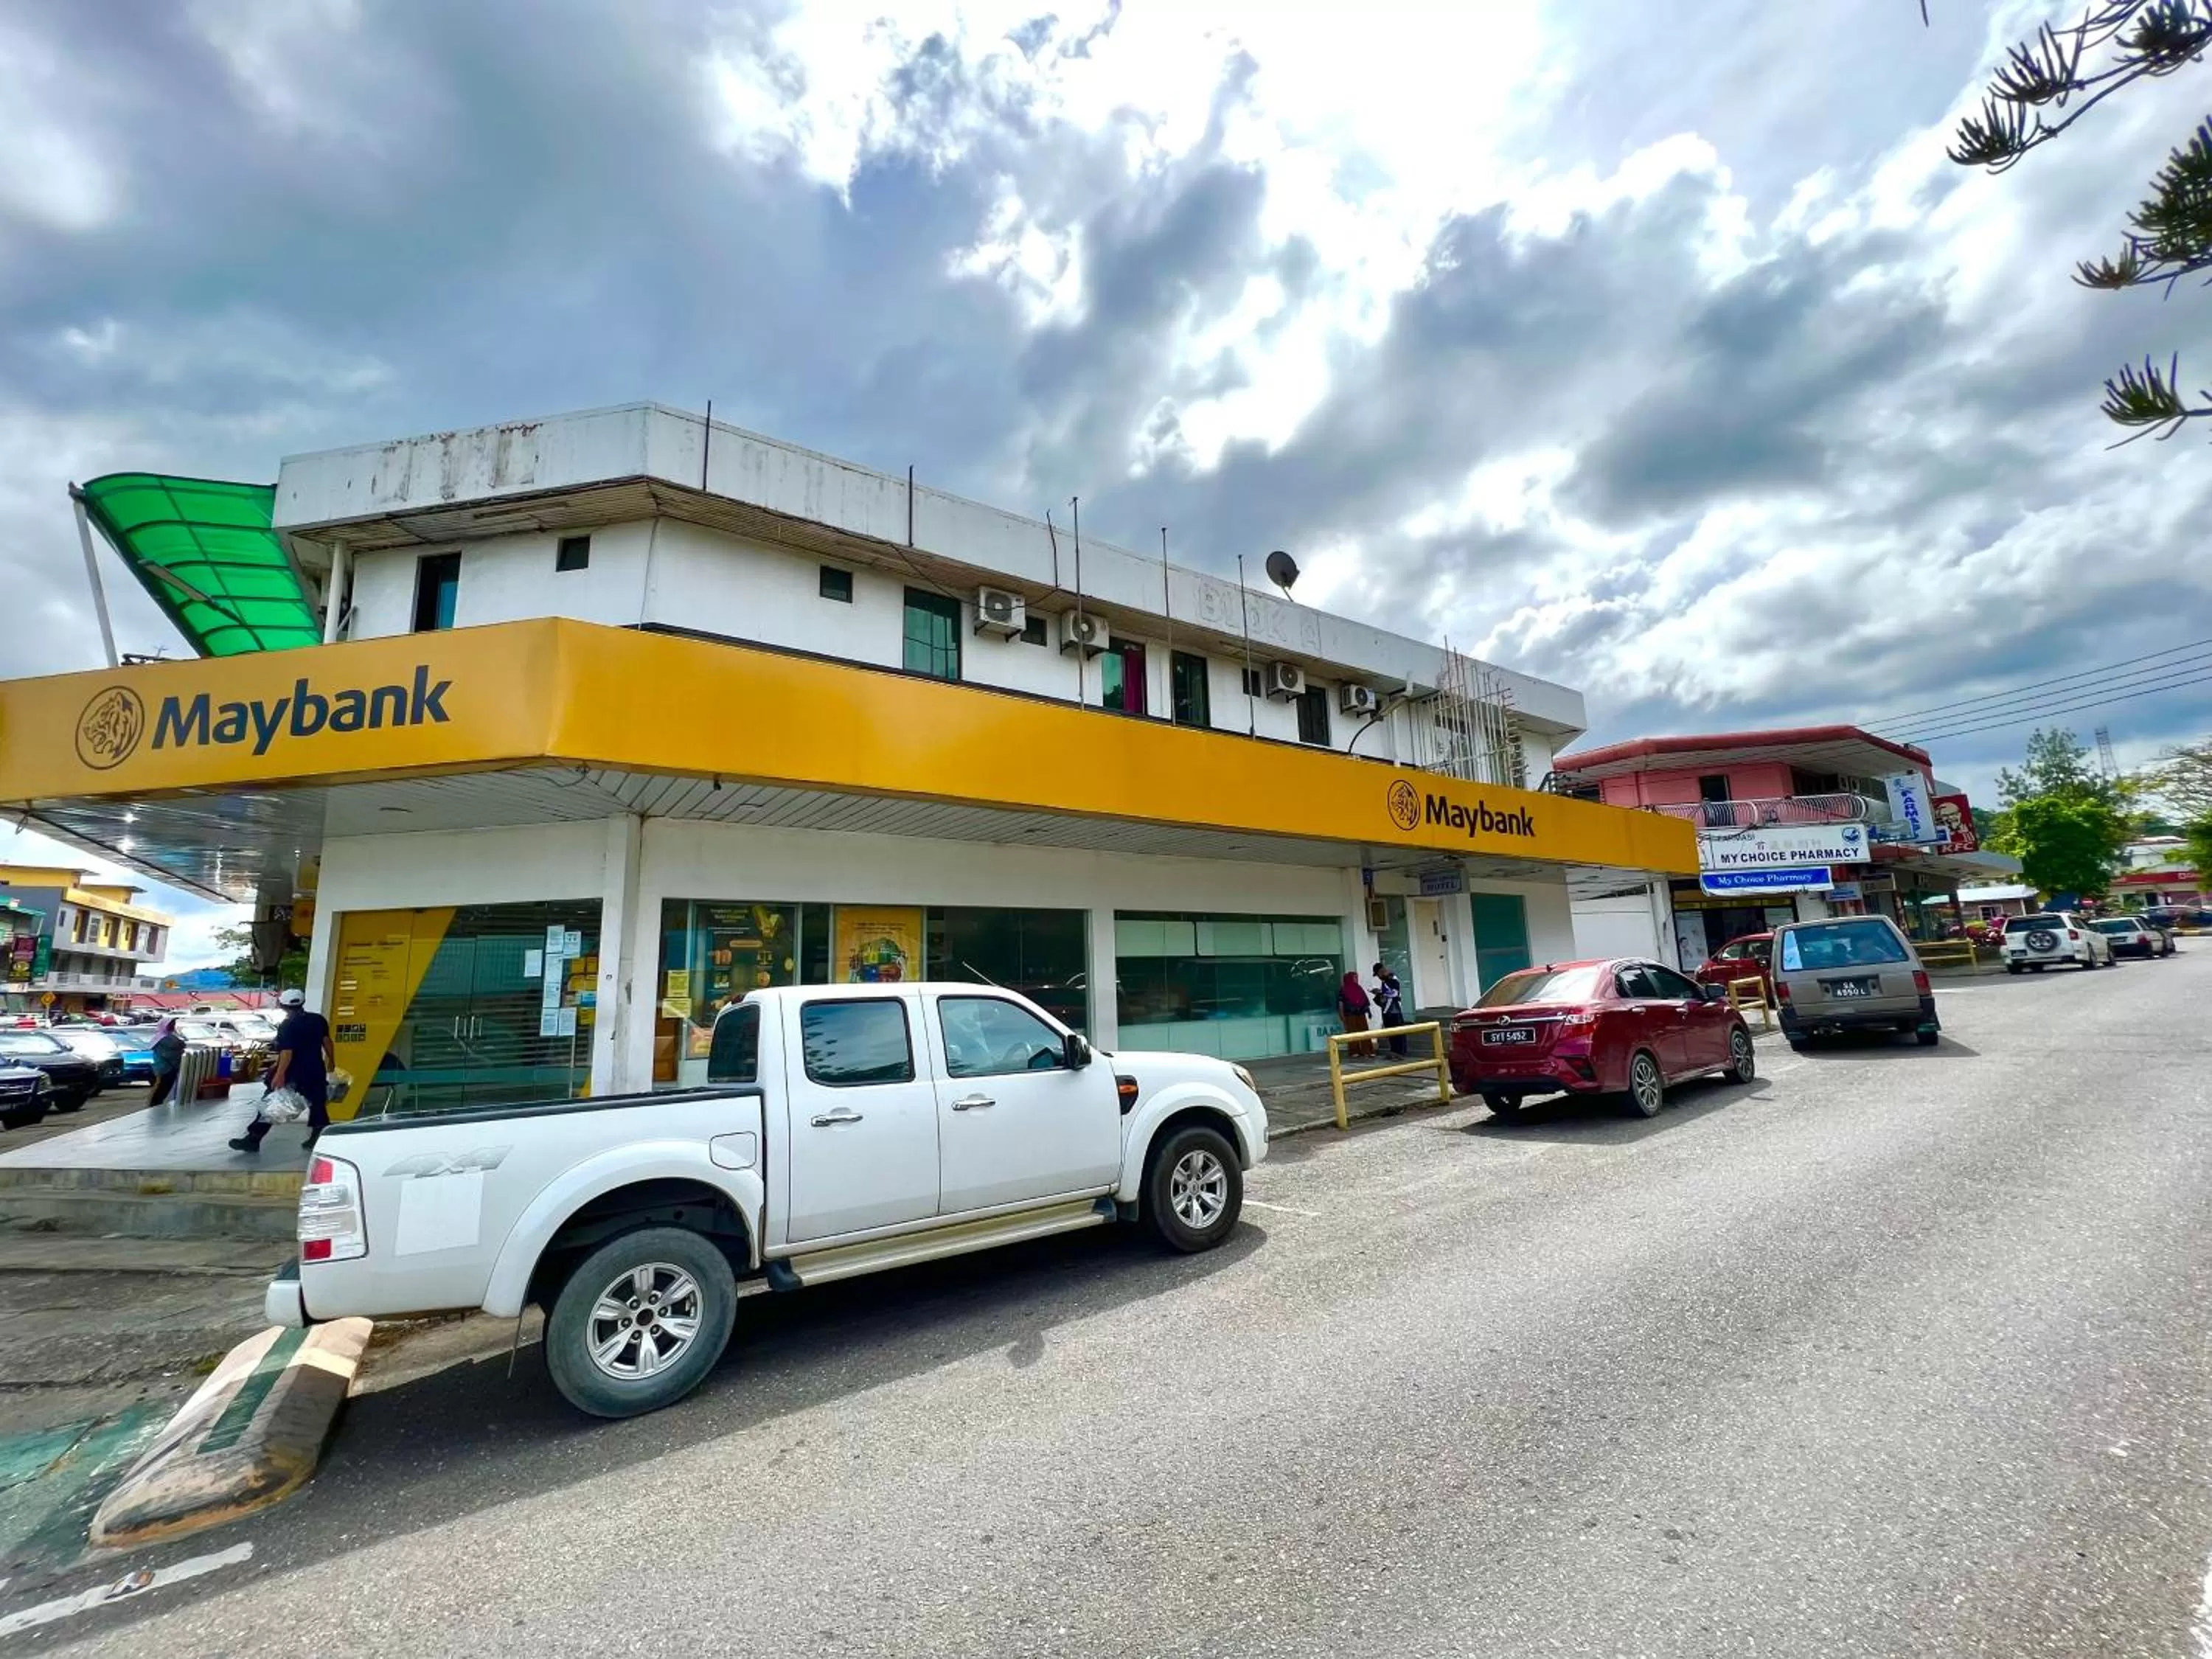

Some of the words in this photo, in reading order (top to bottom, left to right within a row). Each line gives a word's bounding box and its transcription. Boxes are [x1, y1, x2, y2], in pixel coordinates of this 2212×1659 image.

[152, 665, 453, 755] Maybank
[1425, 793, 1536, 838] Maybank
[1720, 853, 1739, 863] MY
[1740, 852, 1787, 862] CHOICE
[1790, 847, 1860, 860] PHARMACY
[1941, 843, 1974, 853] KFC
[1717, 877, 1731, 885] My
[1733, 875, 1764, 884] Choice
[1766, 874, 1812, 883] Pharmacy
